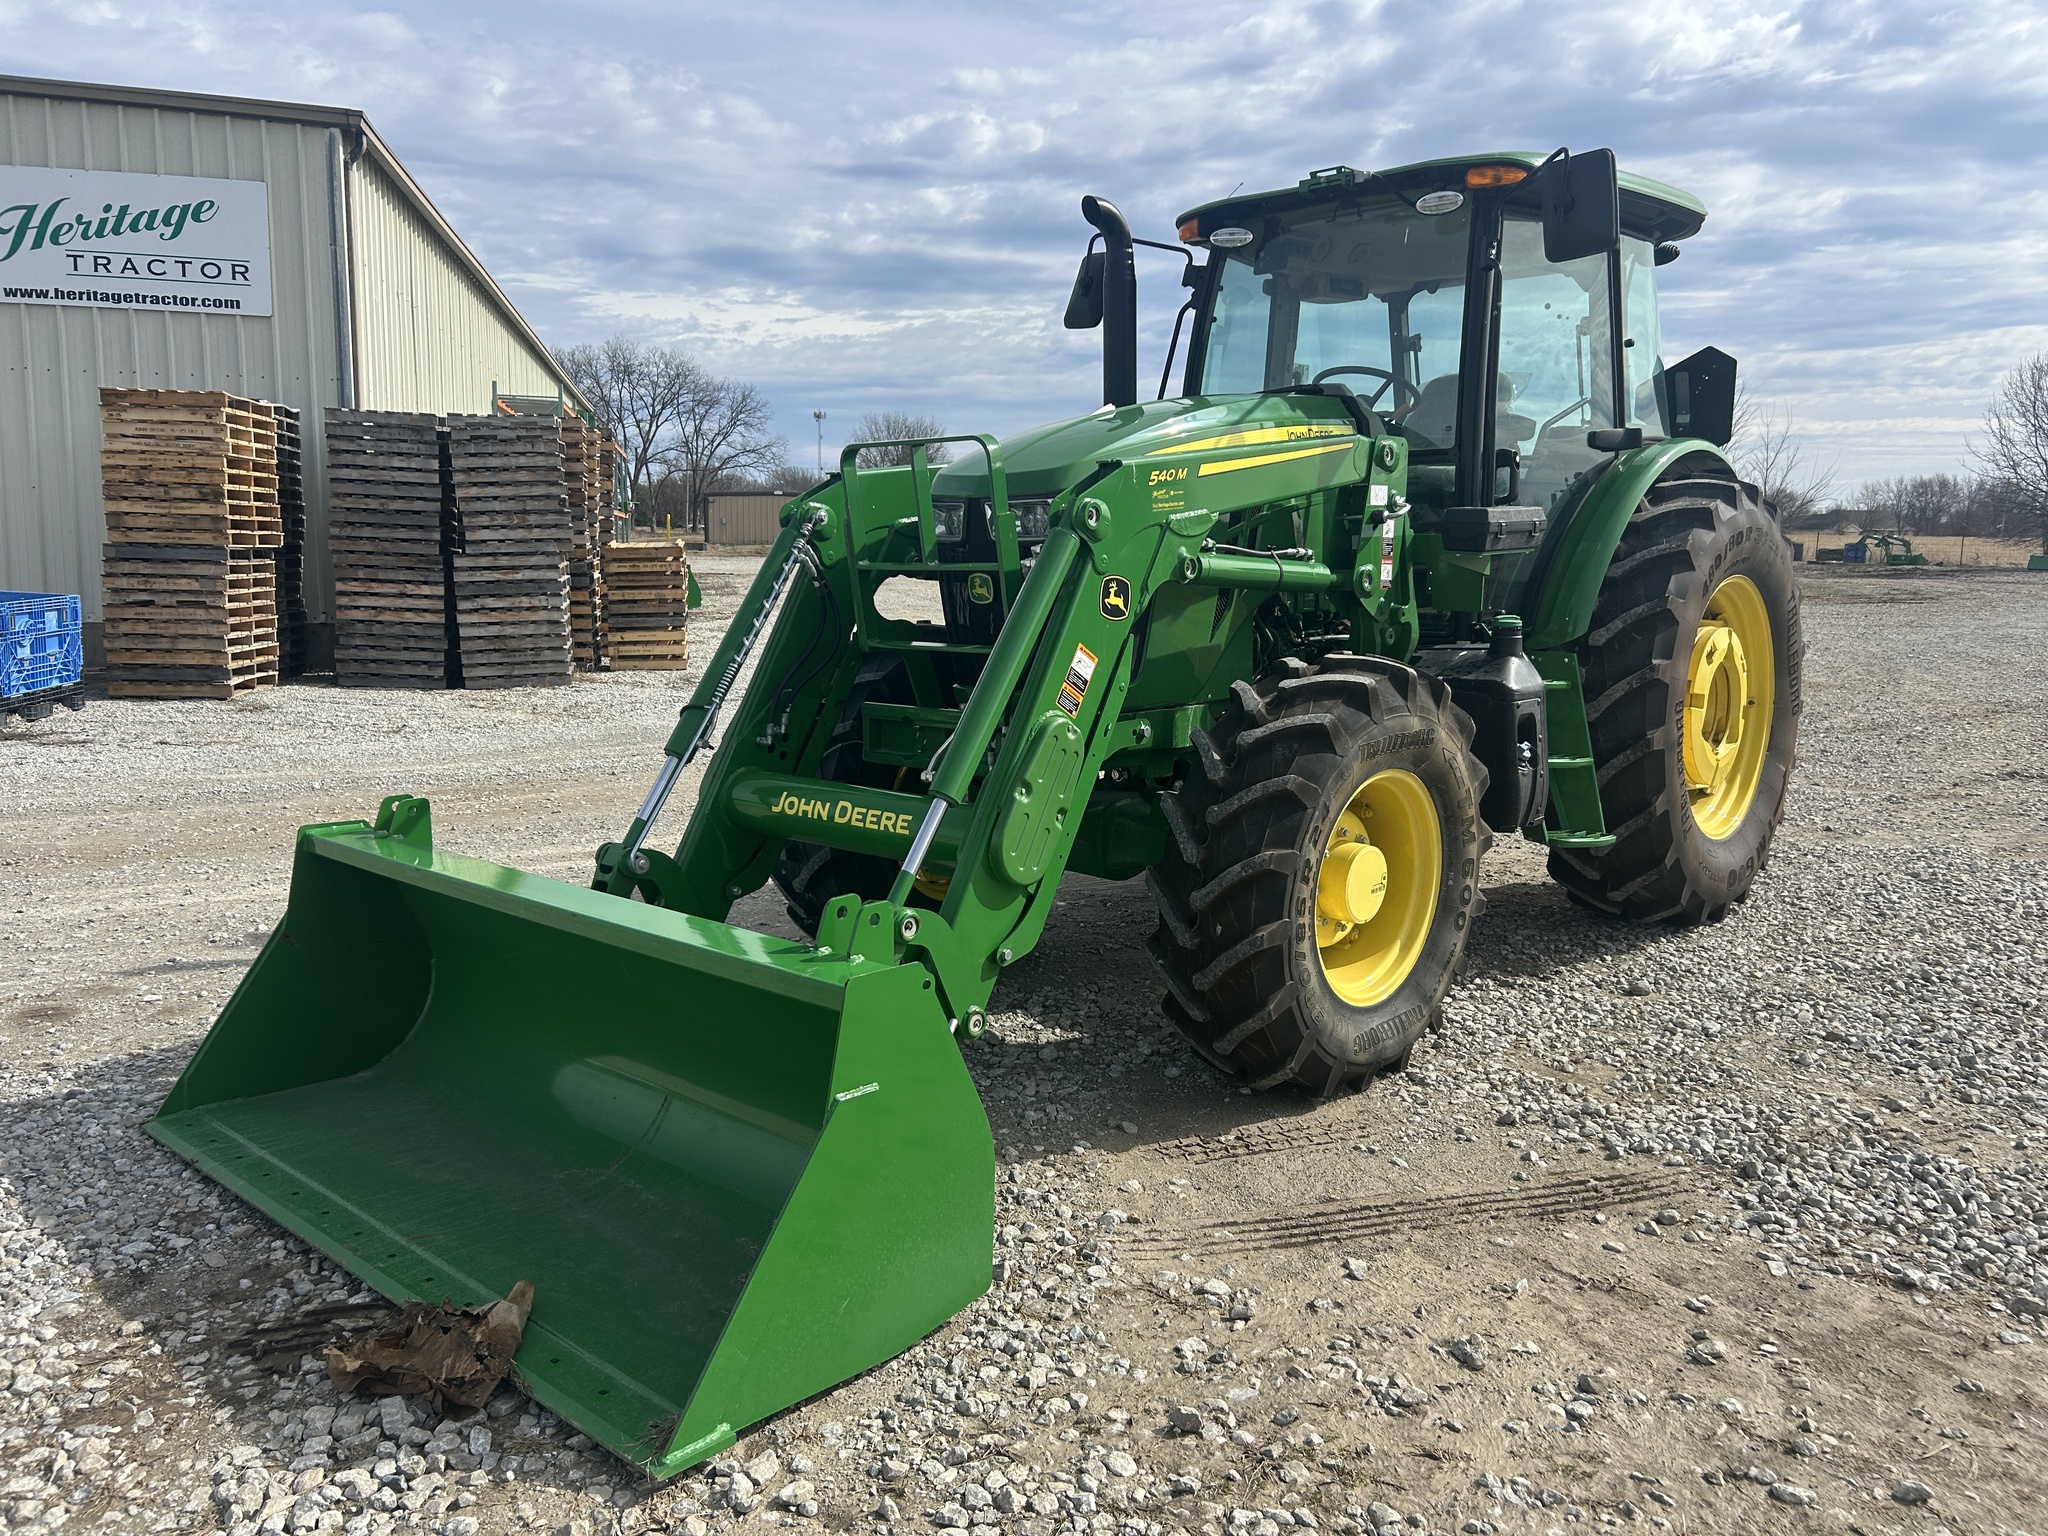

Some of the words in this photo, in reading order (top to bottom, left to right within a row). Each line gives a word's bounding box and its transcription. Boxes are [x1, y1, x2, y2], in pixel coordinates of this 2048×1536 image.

[0, 197, 219, 262] Heritage
[66, 253, 250, 282] TRACTOR
[3, 286, 241, 309] www.heritagetractor.com
[1148, 468, 1176, 486] 540
[1176, 467, 1188, 481] M
[1787, 589, 1800, 718] TRELLEBORG
[1358, 727, 1435, 764] TRELLEBORG
[771, 791, 831, 821] JOHN
[834, 800, 913, 835] DEERE
[1457, 786, 1477, 848] TM
[1299, 857, 1314, 887] R
[1453, 857, 1476, 934] 600
[1352, 1004, 1426, 1057] TRELLEBORG
